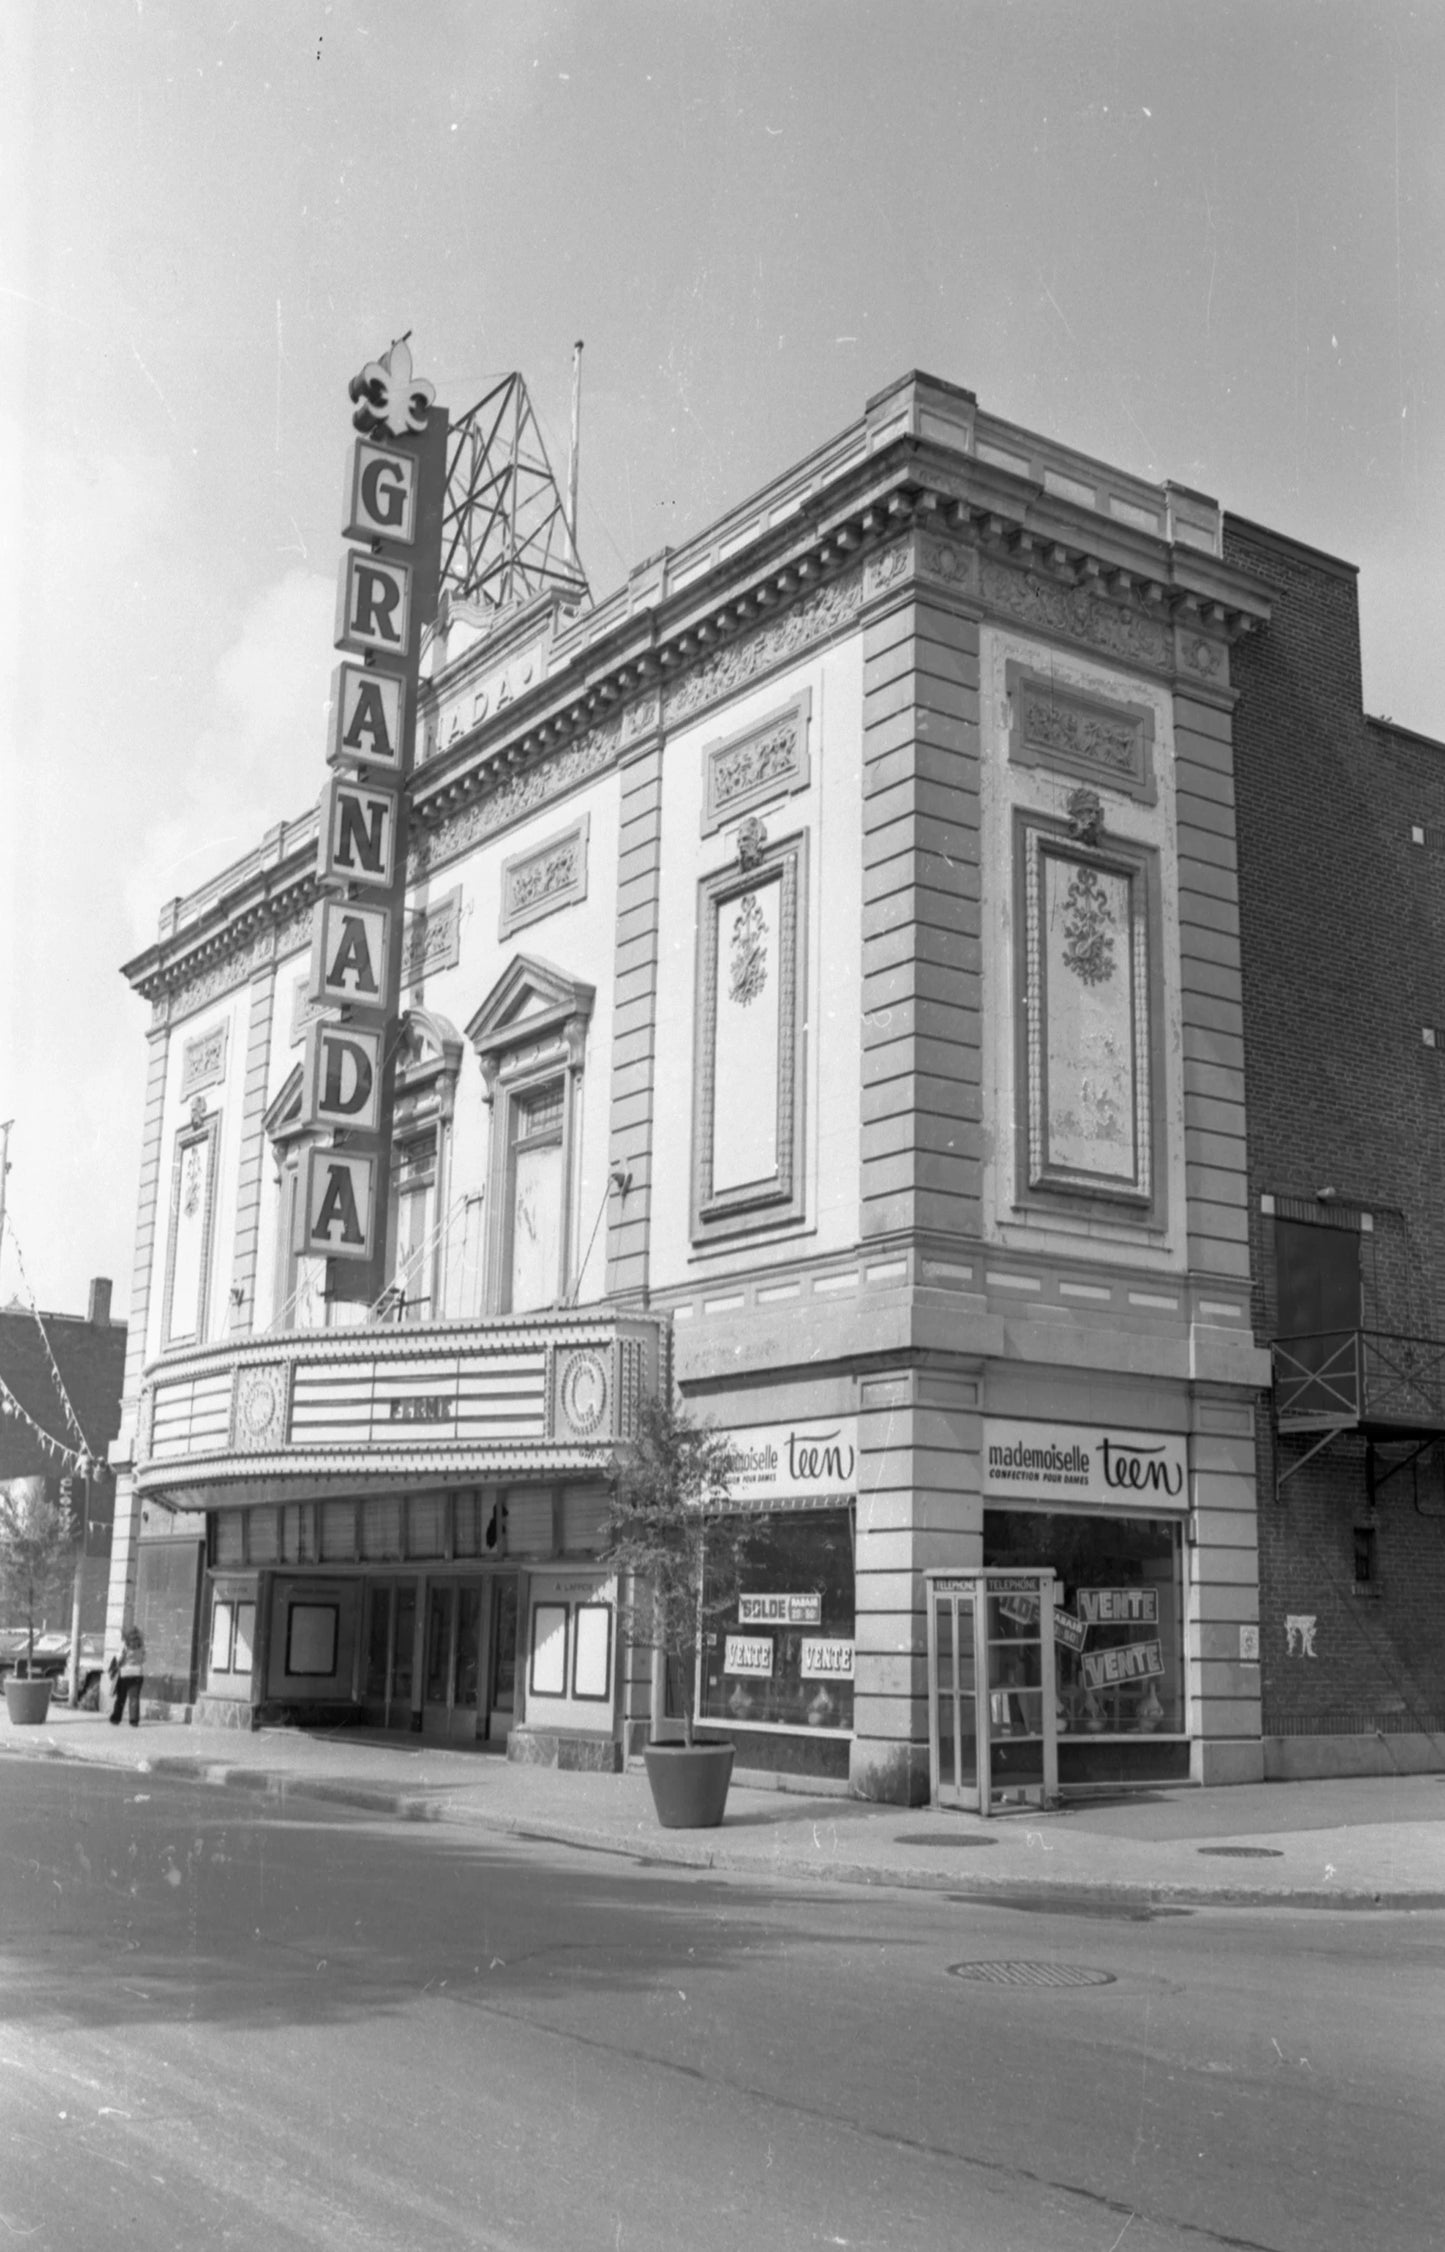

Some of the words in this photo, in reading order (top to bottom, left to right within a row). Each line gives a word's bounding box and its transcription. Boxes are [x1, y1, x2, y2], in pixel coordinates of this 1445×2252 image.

[310, 458, 408, 1246] GRANADA
[784, 1429, 854, 1481] teen
[988, 1440, 1090, 1474] mademoiselle
[1095, 1437, 1183, 1496] teen
[988, 1469, 1040, 1482] CONFECTION
[1042, 1473, 1062, 1484] POUR
[1064, 1474, 1089, 1486] DAMES
[741, 1599, 786, 1619] SOLDE
[1080, 1591, 1155, 1621] VENTE
[729, 1643, 771, 1669] VENTE
[806, 1645, 852, 1671] VENTE
[1085, 1645, 1161, 1686] VENTE
